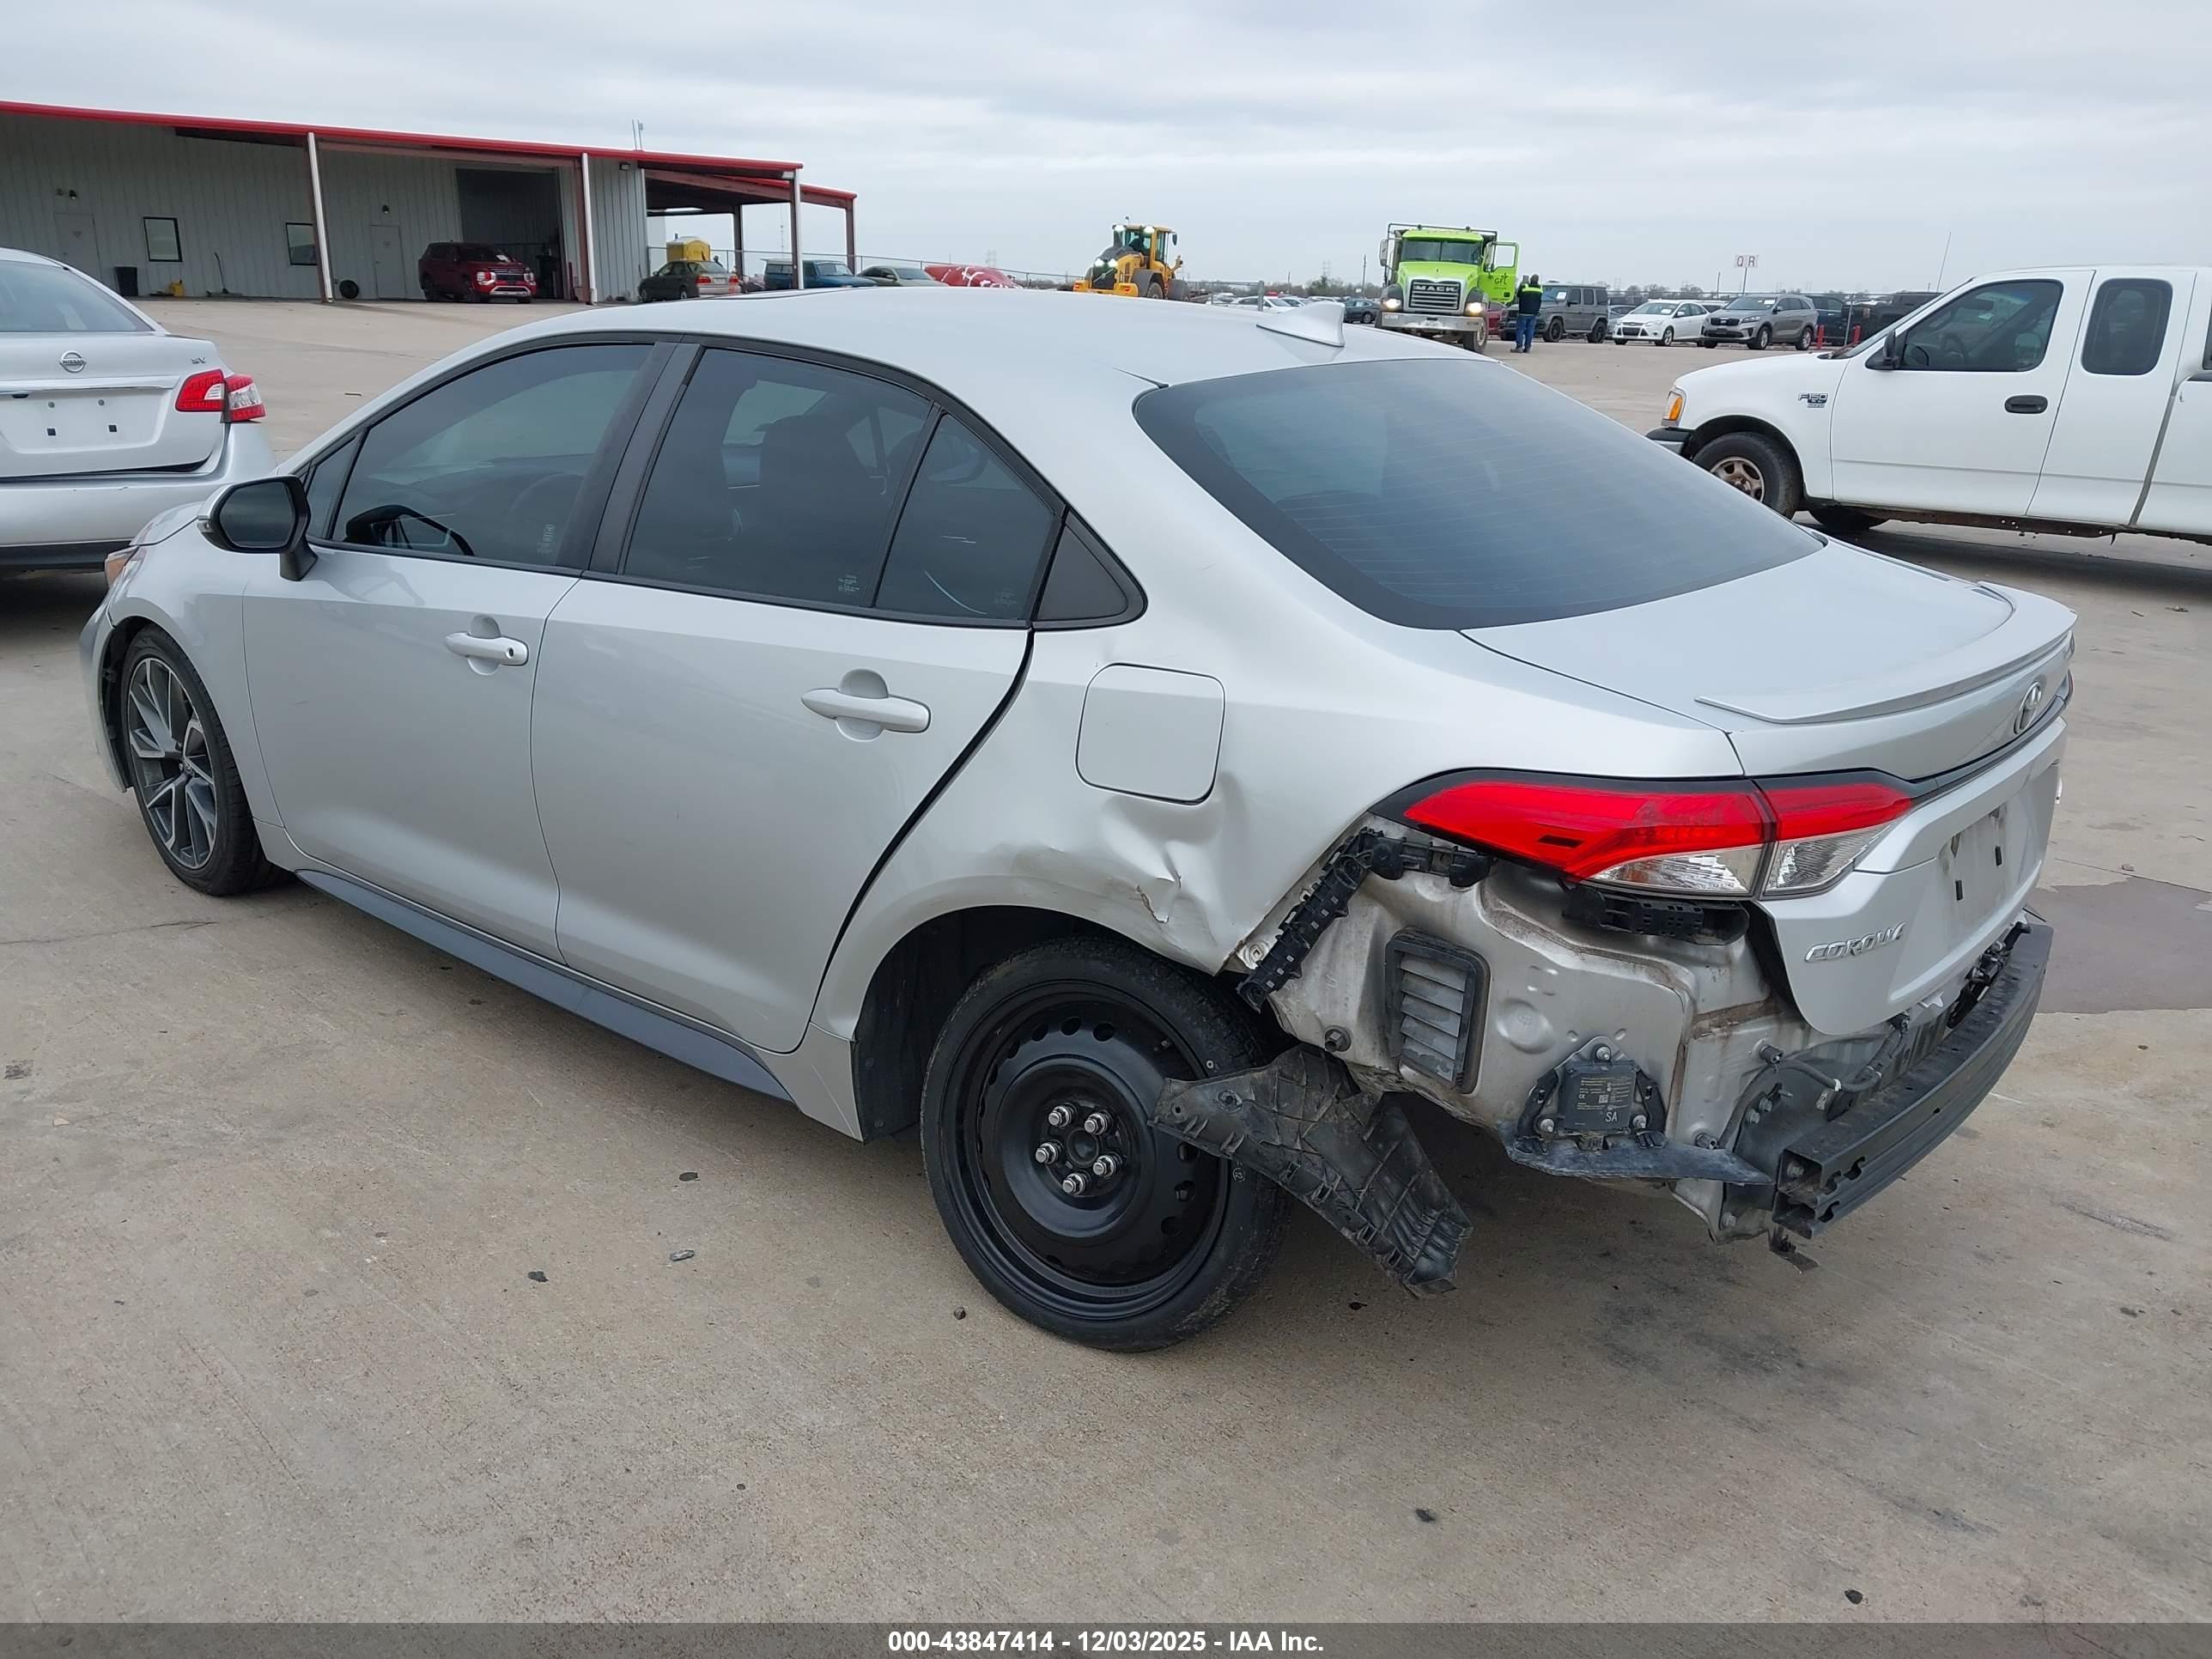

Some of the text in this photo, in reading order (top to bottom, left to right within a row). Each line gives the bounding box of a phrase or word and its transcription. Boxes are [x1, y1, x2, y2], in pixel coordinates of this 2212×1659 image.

[191, 356, 206, 365] SV
[1804, 921, 1905, 963] COROLLA
[1605, 1111, 1618, 1122] SA
